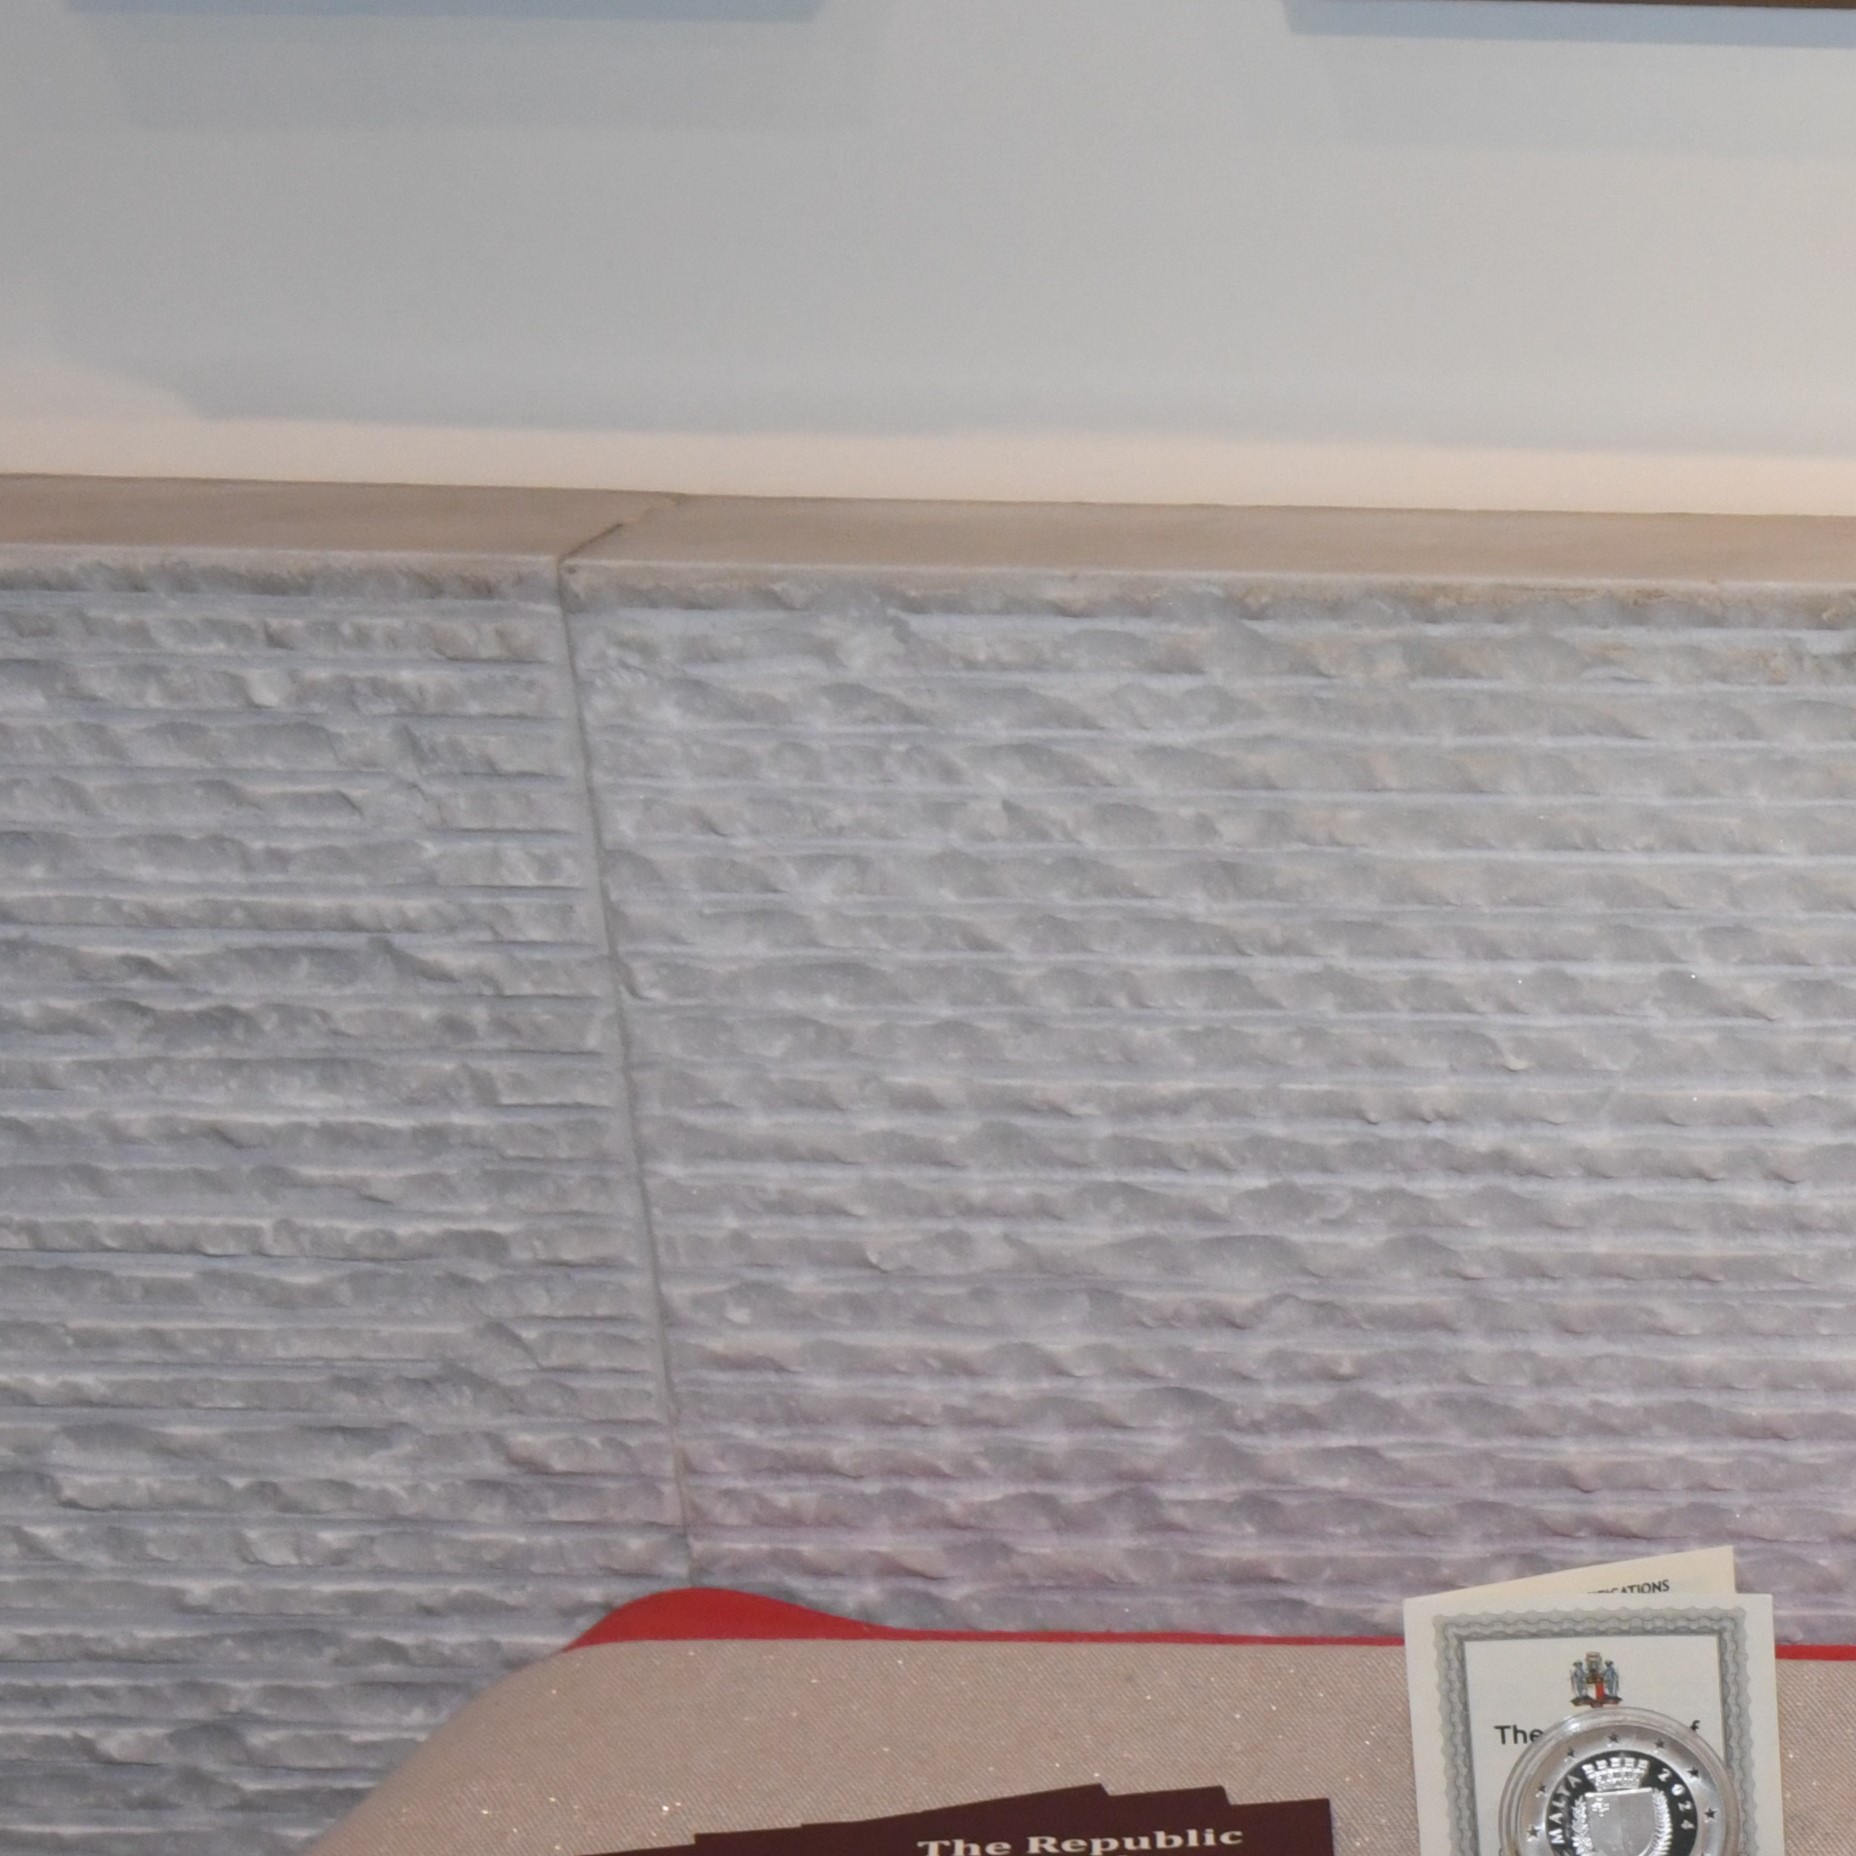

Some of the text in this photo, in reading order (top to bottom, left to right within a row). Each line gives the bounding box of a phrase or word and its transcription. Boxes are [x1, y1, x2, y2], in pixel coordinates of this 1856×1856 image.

[1549, 1775, 1582, 1844] MALTA
[1658, 1768, 1694, 1830] 2024
[1026, 1828, 1244, 1856] Republic
